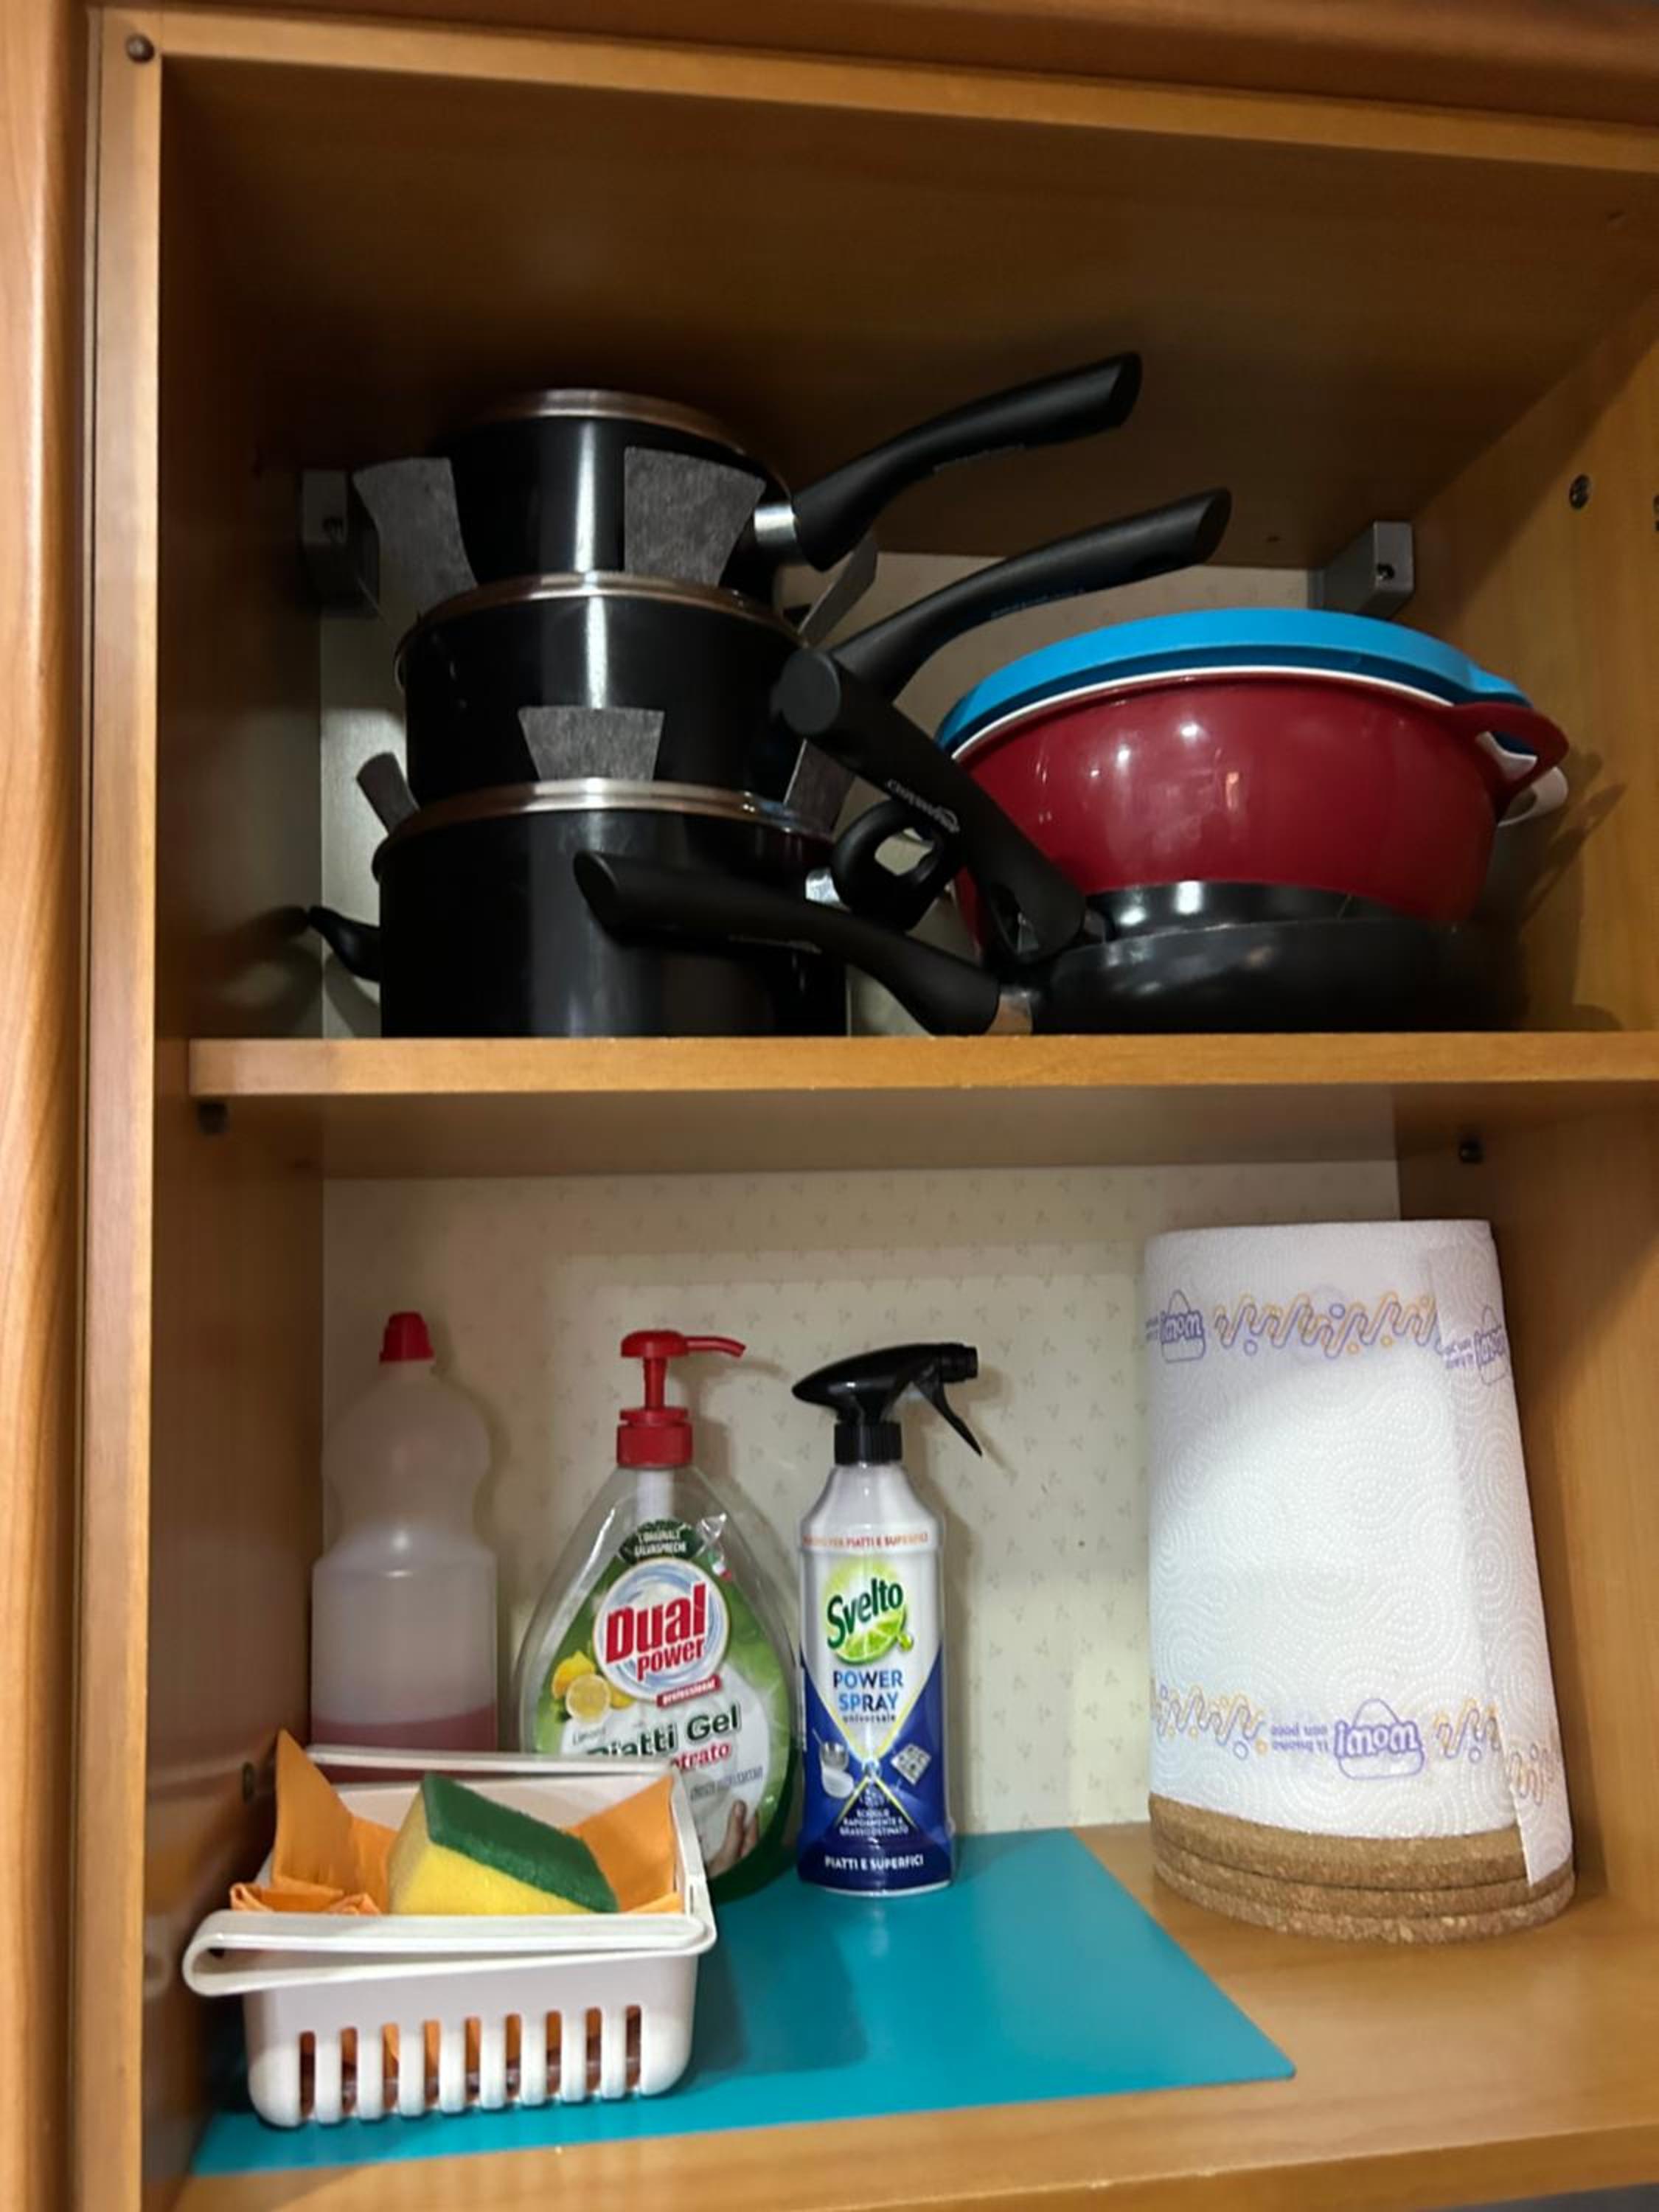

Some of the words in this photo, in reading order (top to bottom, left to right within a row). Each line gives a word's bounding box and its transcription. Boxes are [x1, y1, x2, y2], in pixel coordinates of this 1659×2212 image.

[606, 1582, 706, 1664] Dual
[827, 1578, 904, 1649] Svelto
[833, 1669, 903, 1688] POWER
[839, 1693, 899, 1712] SPRAY
[686, 1703, 740, 1742] Gel
[824, 1854, 858, 1870] PIATTI
[860, 1857, 868, 1871] E
[869, 1853, 924, 1871] SUPERFICI
